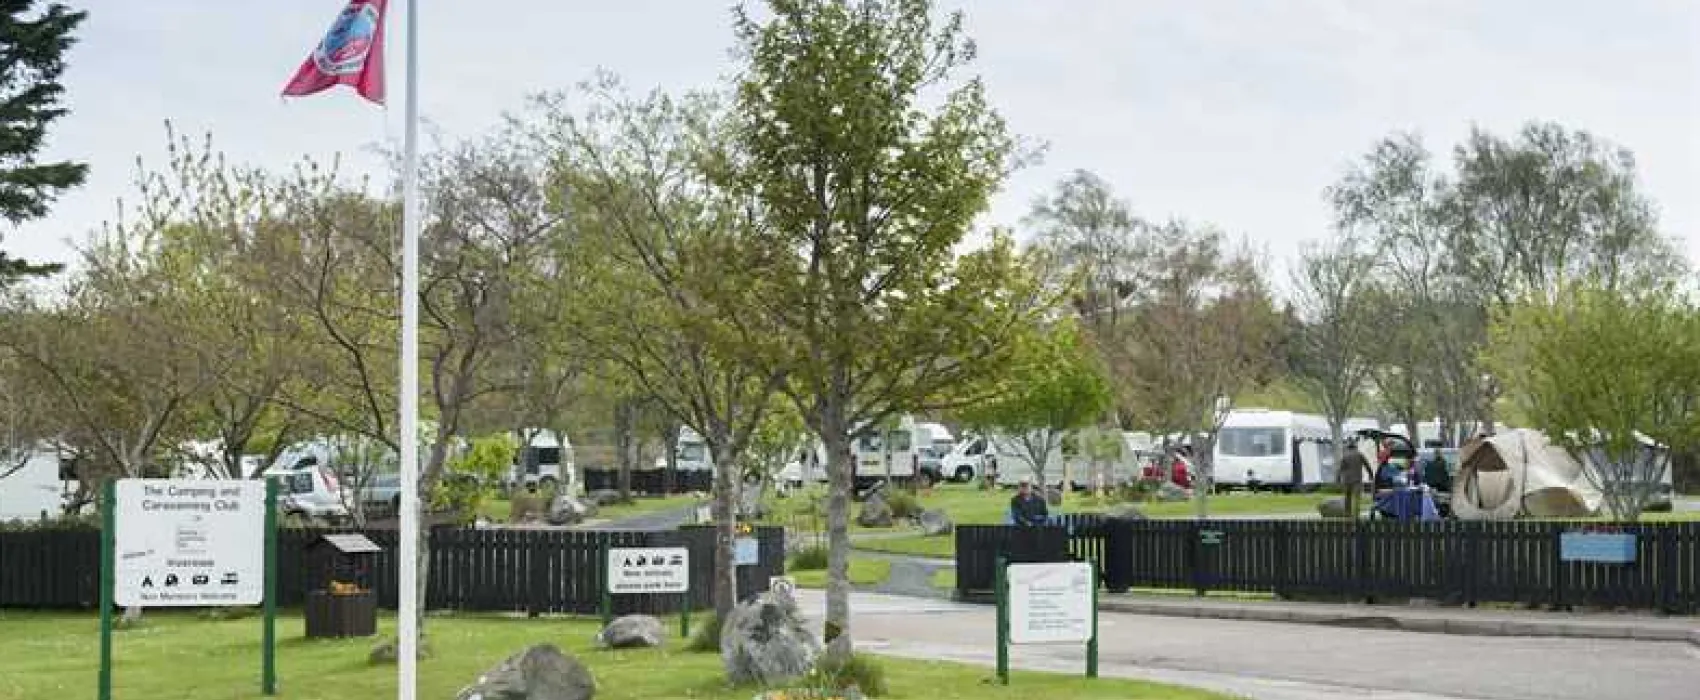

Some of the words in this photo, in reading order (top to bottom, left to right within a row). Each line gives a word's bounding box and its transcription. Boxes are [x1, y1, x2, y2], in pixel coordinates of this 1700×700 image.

[145, 485, 162, 496] The
[168, 485, 216, 498] Camping
[214, 499, 240, 511] Club
